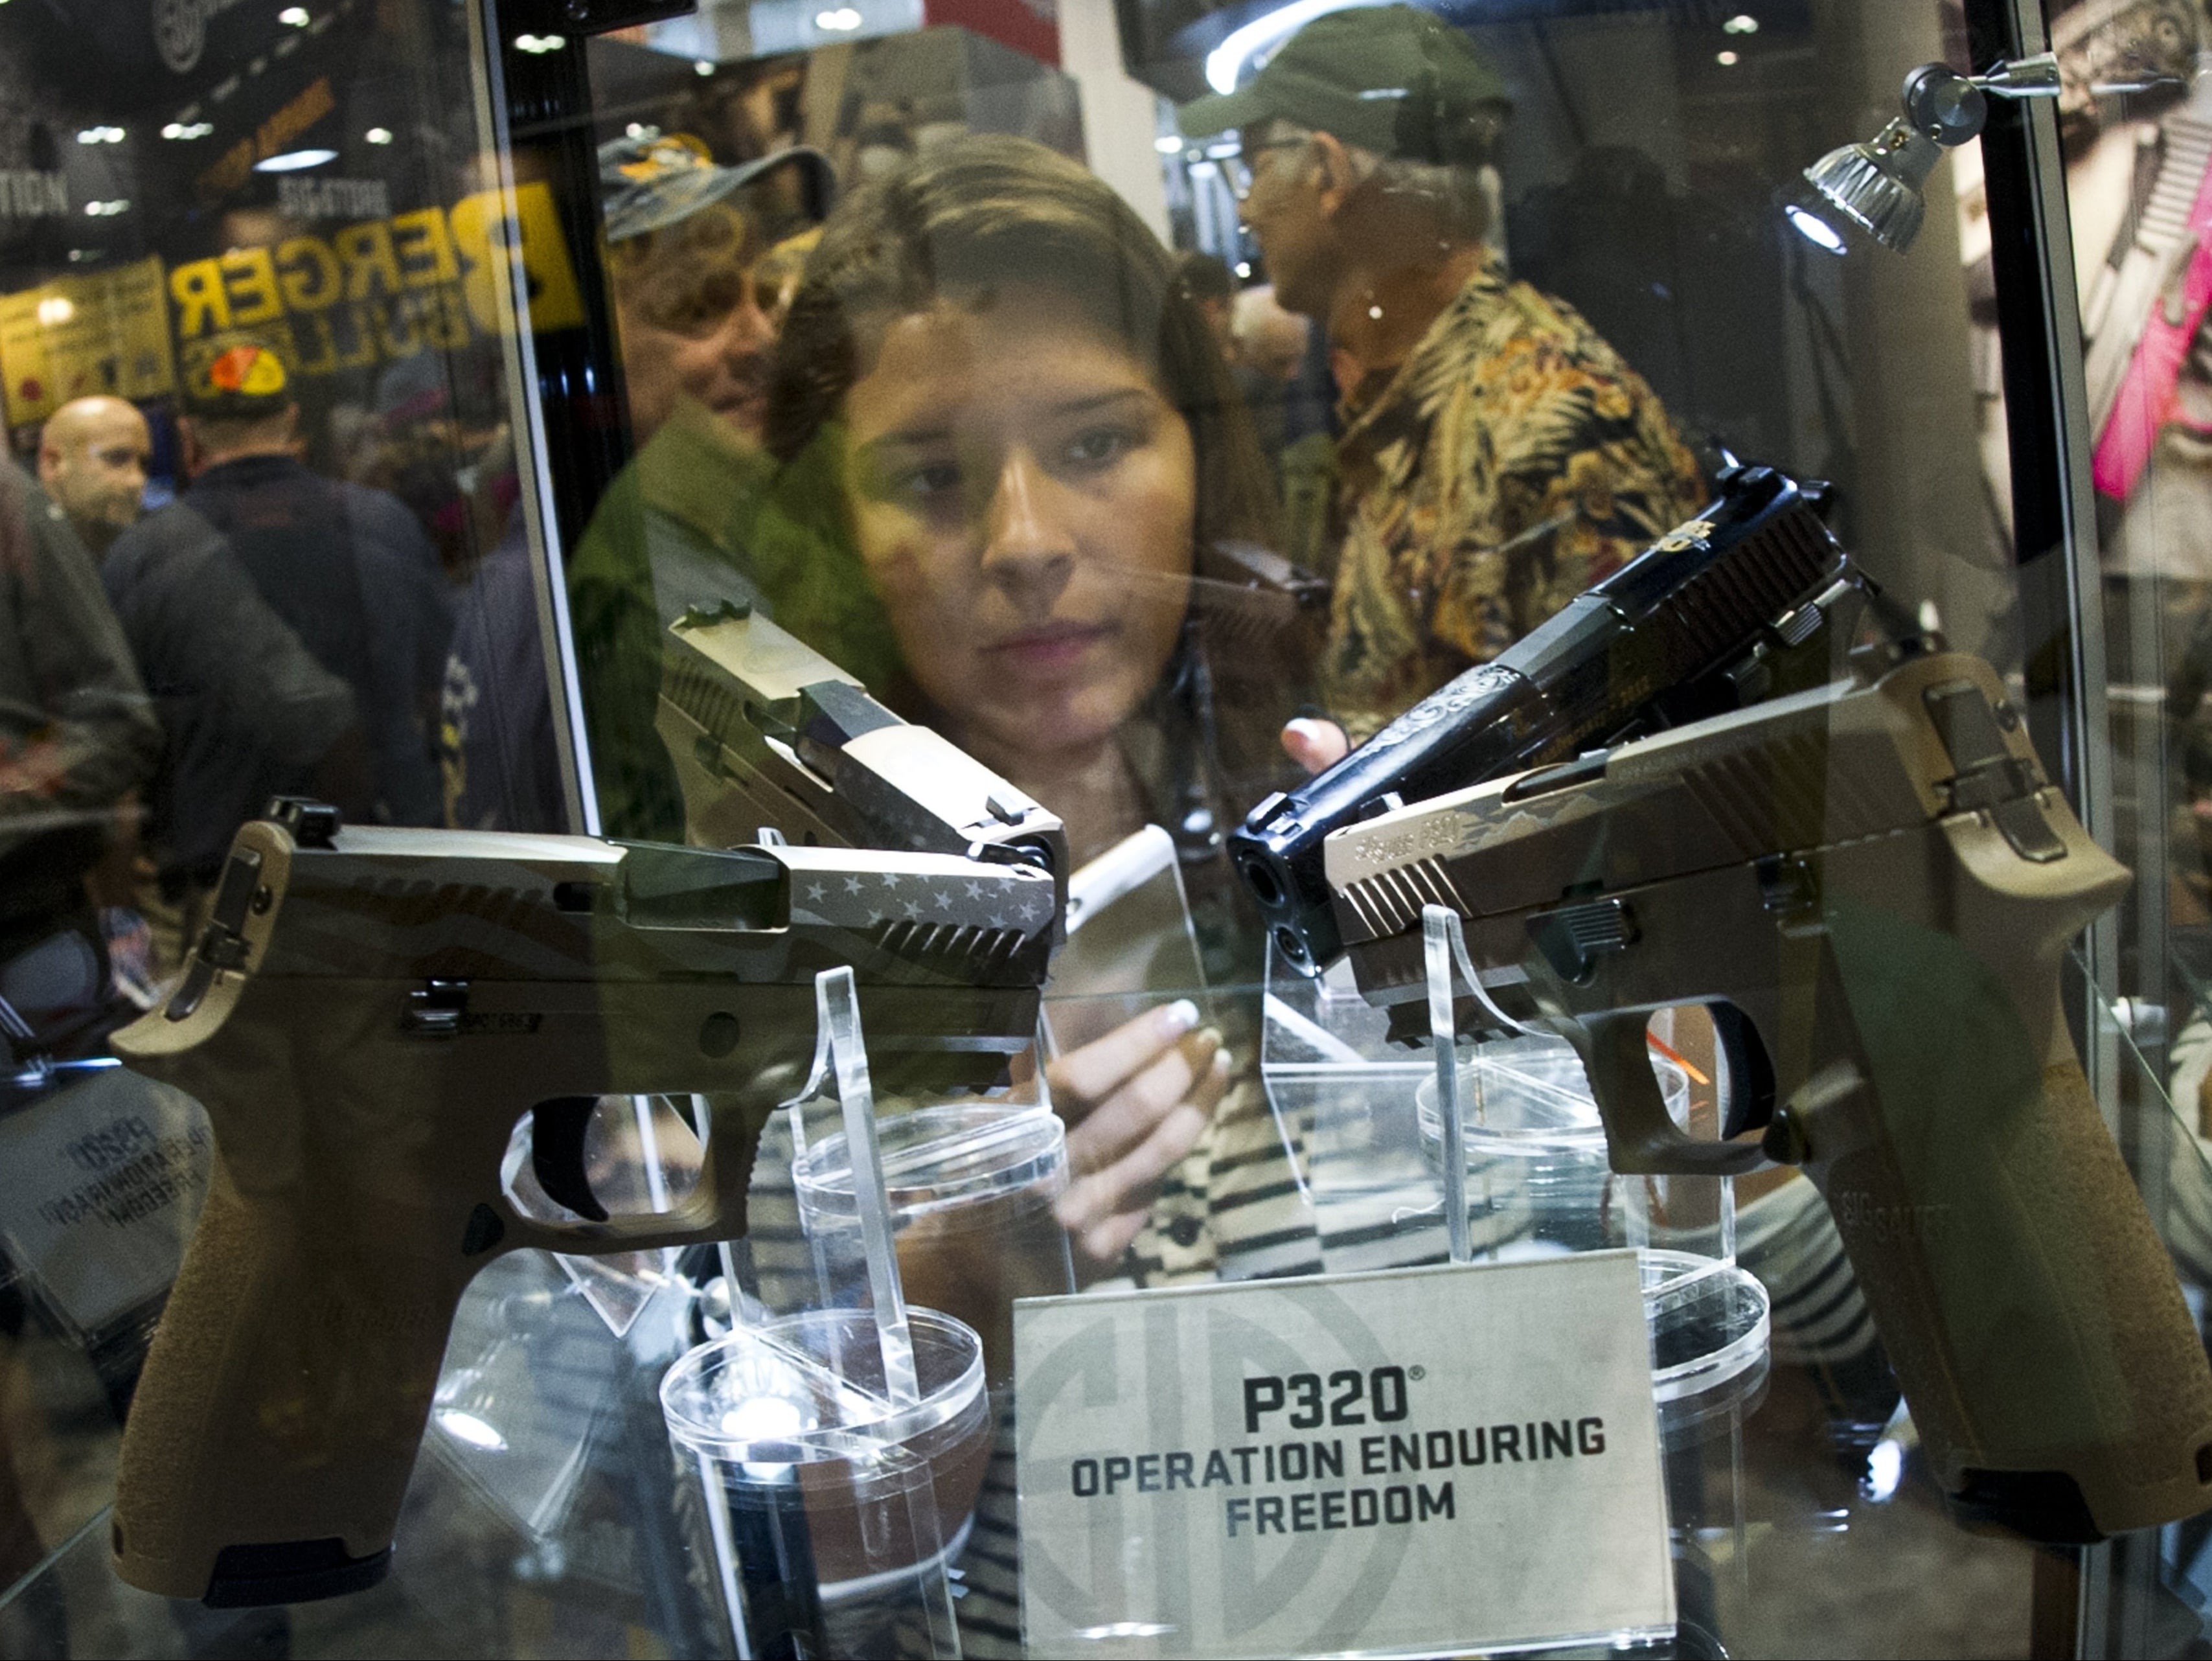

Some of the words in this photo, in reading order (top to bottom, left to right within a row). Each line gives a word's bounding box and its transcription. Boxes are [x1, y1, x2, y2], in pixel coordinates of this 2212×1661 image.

[1071, 1438, 1345, 1498] OPERATION
[1360, 1416, 1606, 1476] ENDURING
[1226, 1481, 1456, 1537] FREEDOM
